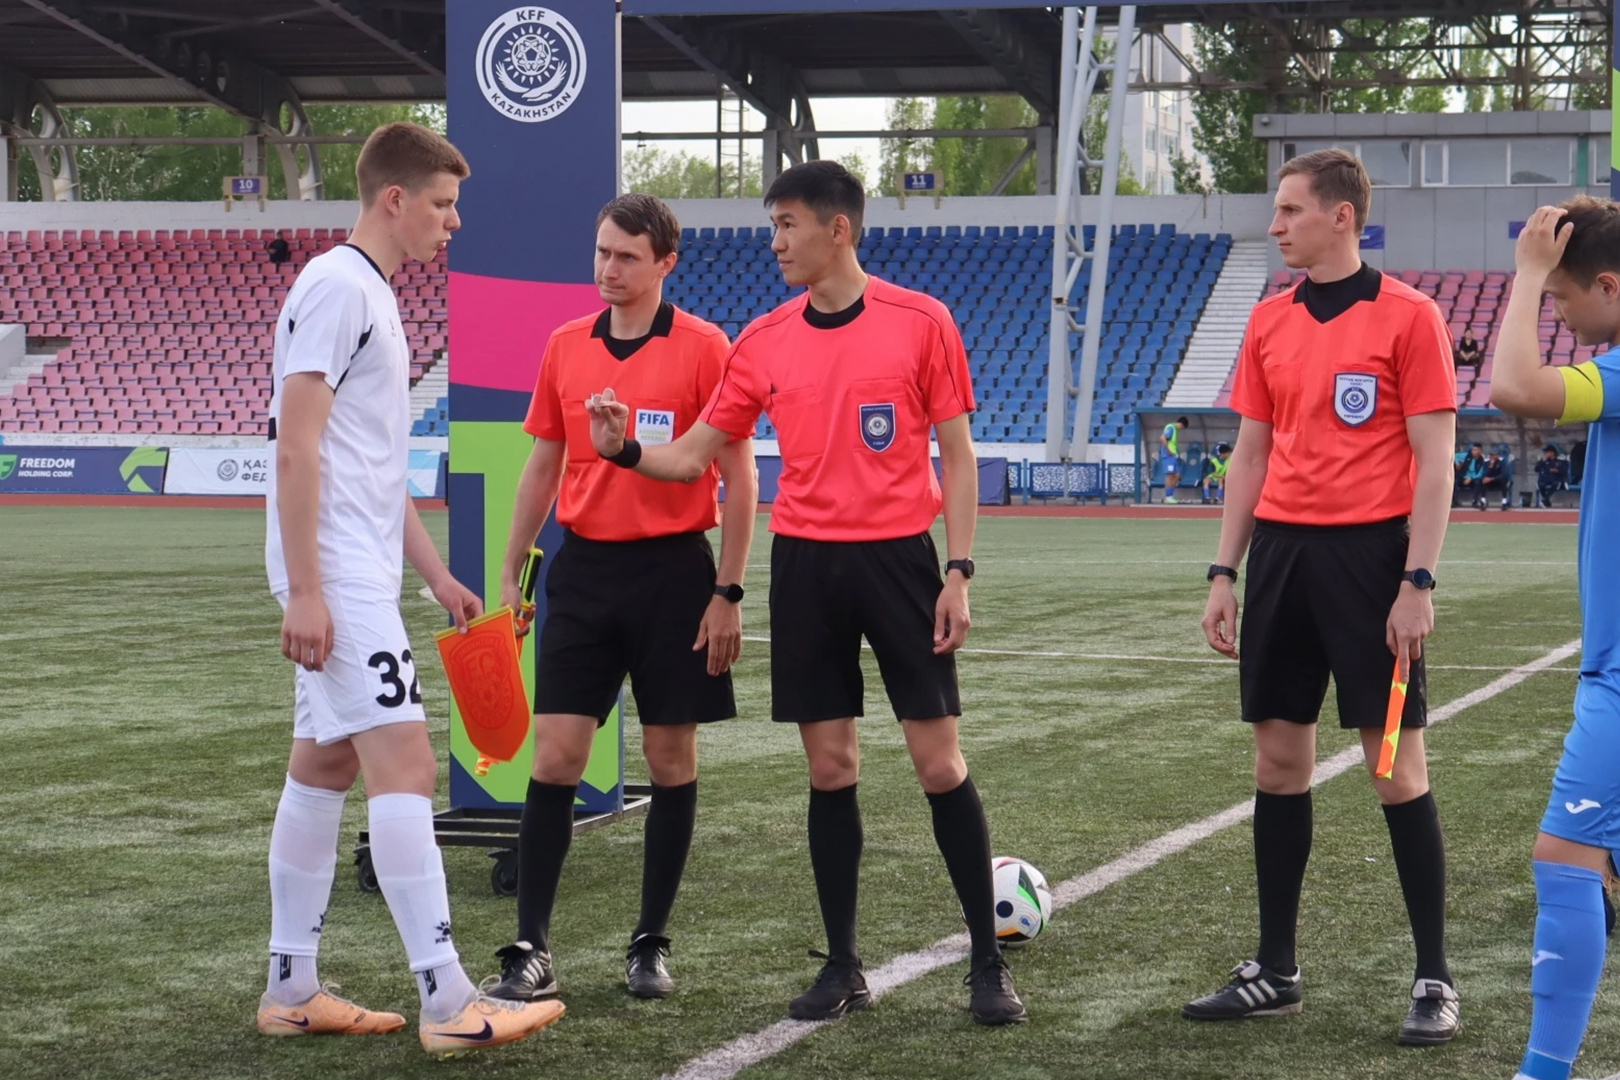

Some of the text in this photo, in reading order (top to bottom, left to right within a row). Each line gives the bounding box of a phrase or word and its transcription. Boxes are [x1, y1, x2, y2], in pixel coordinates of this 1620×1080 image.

[516, 9, 545, 22] KFF
[491, 92, 571, 118] KAZAKHSTAN
[239, 179, 253, 190] 10
[911, 174, 926, 185] 11
[638, 412, 669, 426] FIFA
[20, 457, 76, 469] FREEDOM
[18, 470, 74, 478] HOLDING CORP.
[367, 648, 422, 709] 32
